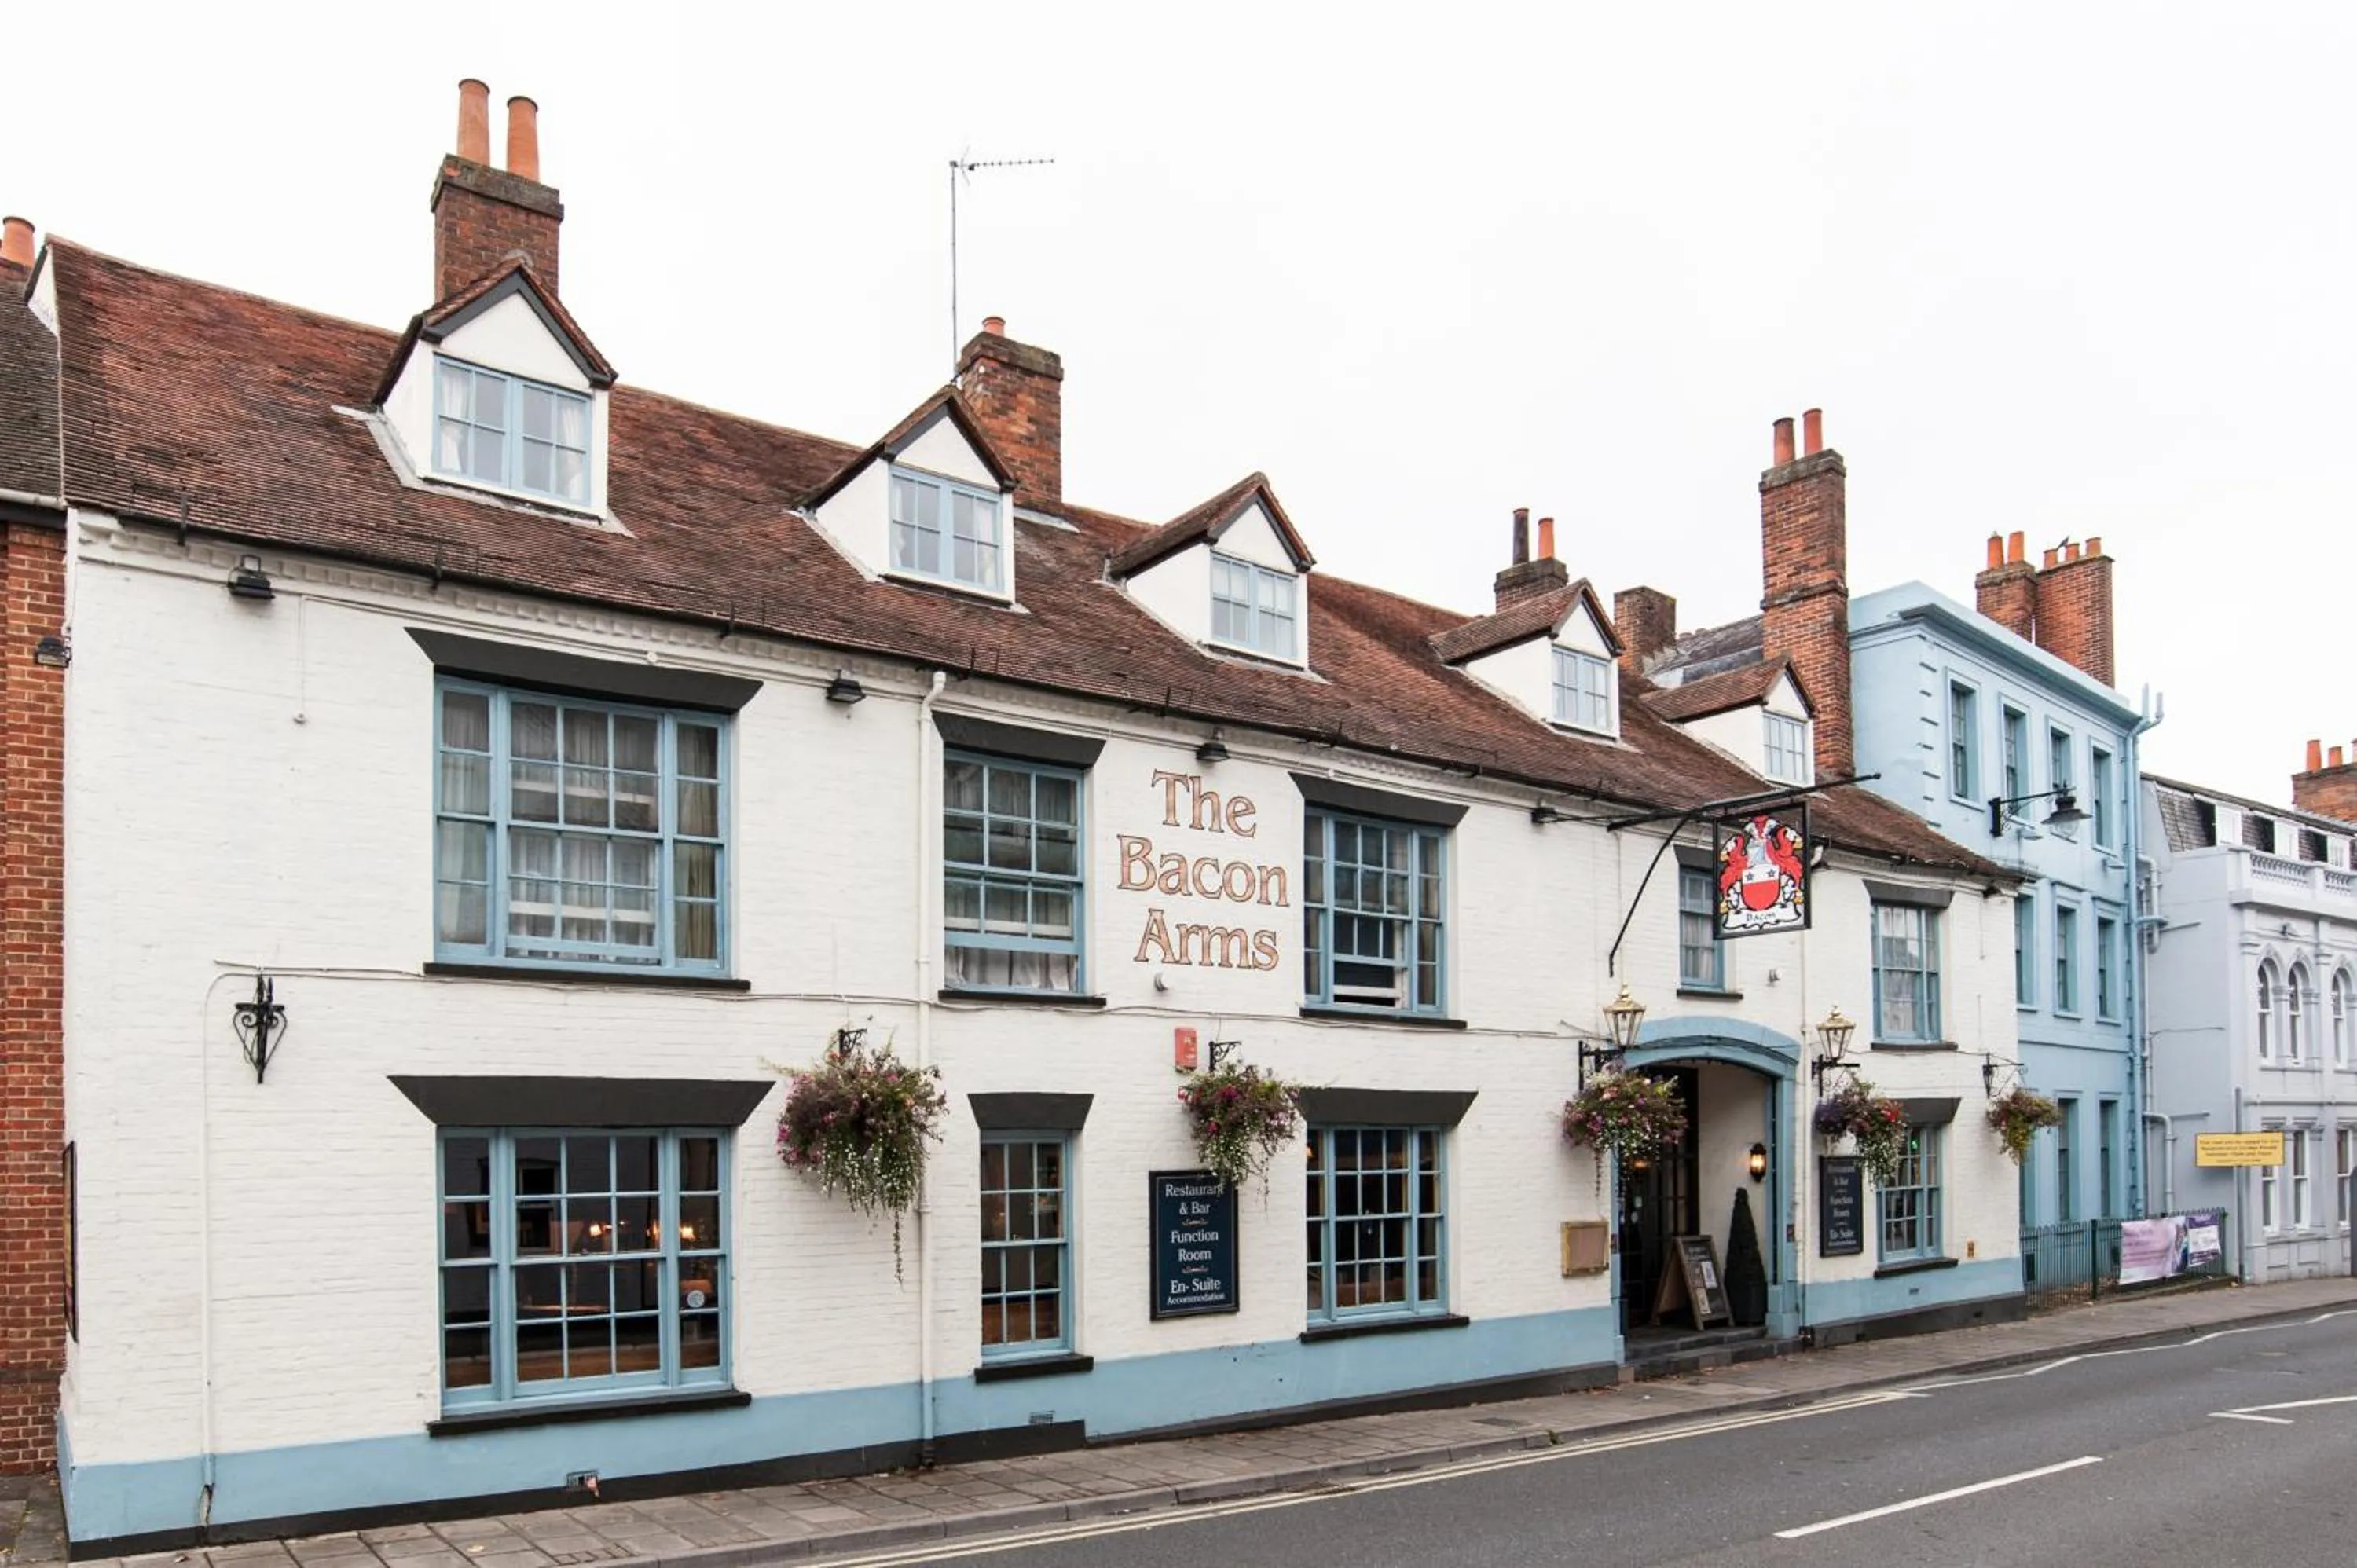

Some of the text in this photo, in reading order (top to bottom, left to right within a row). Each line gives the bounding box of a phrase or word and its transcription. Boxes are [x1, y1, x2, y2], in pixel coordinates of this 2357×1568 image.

[1151, 768, 1256, 837] The
[1116, 833, 1290, 907] Bacon
[1133, 907, 1279, 971] Arms
[1179, 1201, 1210, 1215] & Bar
[1171, 1229, 1219, 1244] Function
[1178, 1248, 1211, 1262] Room
